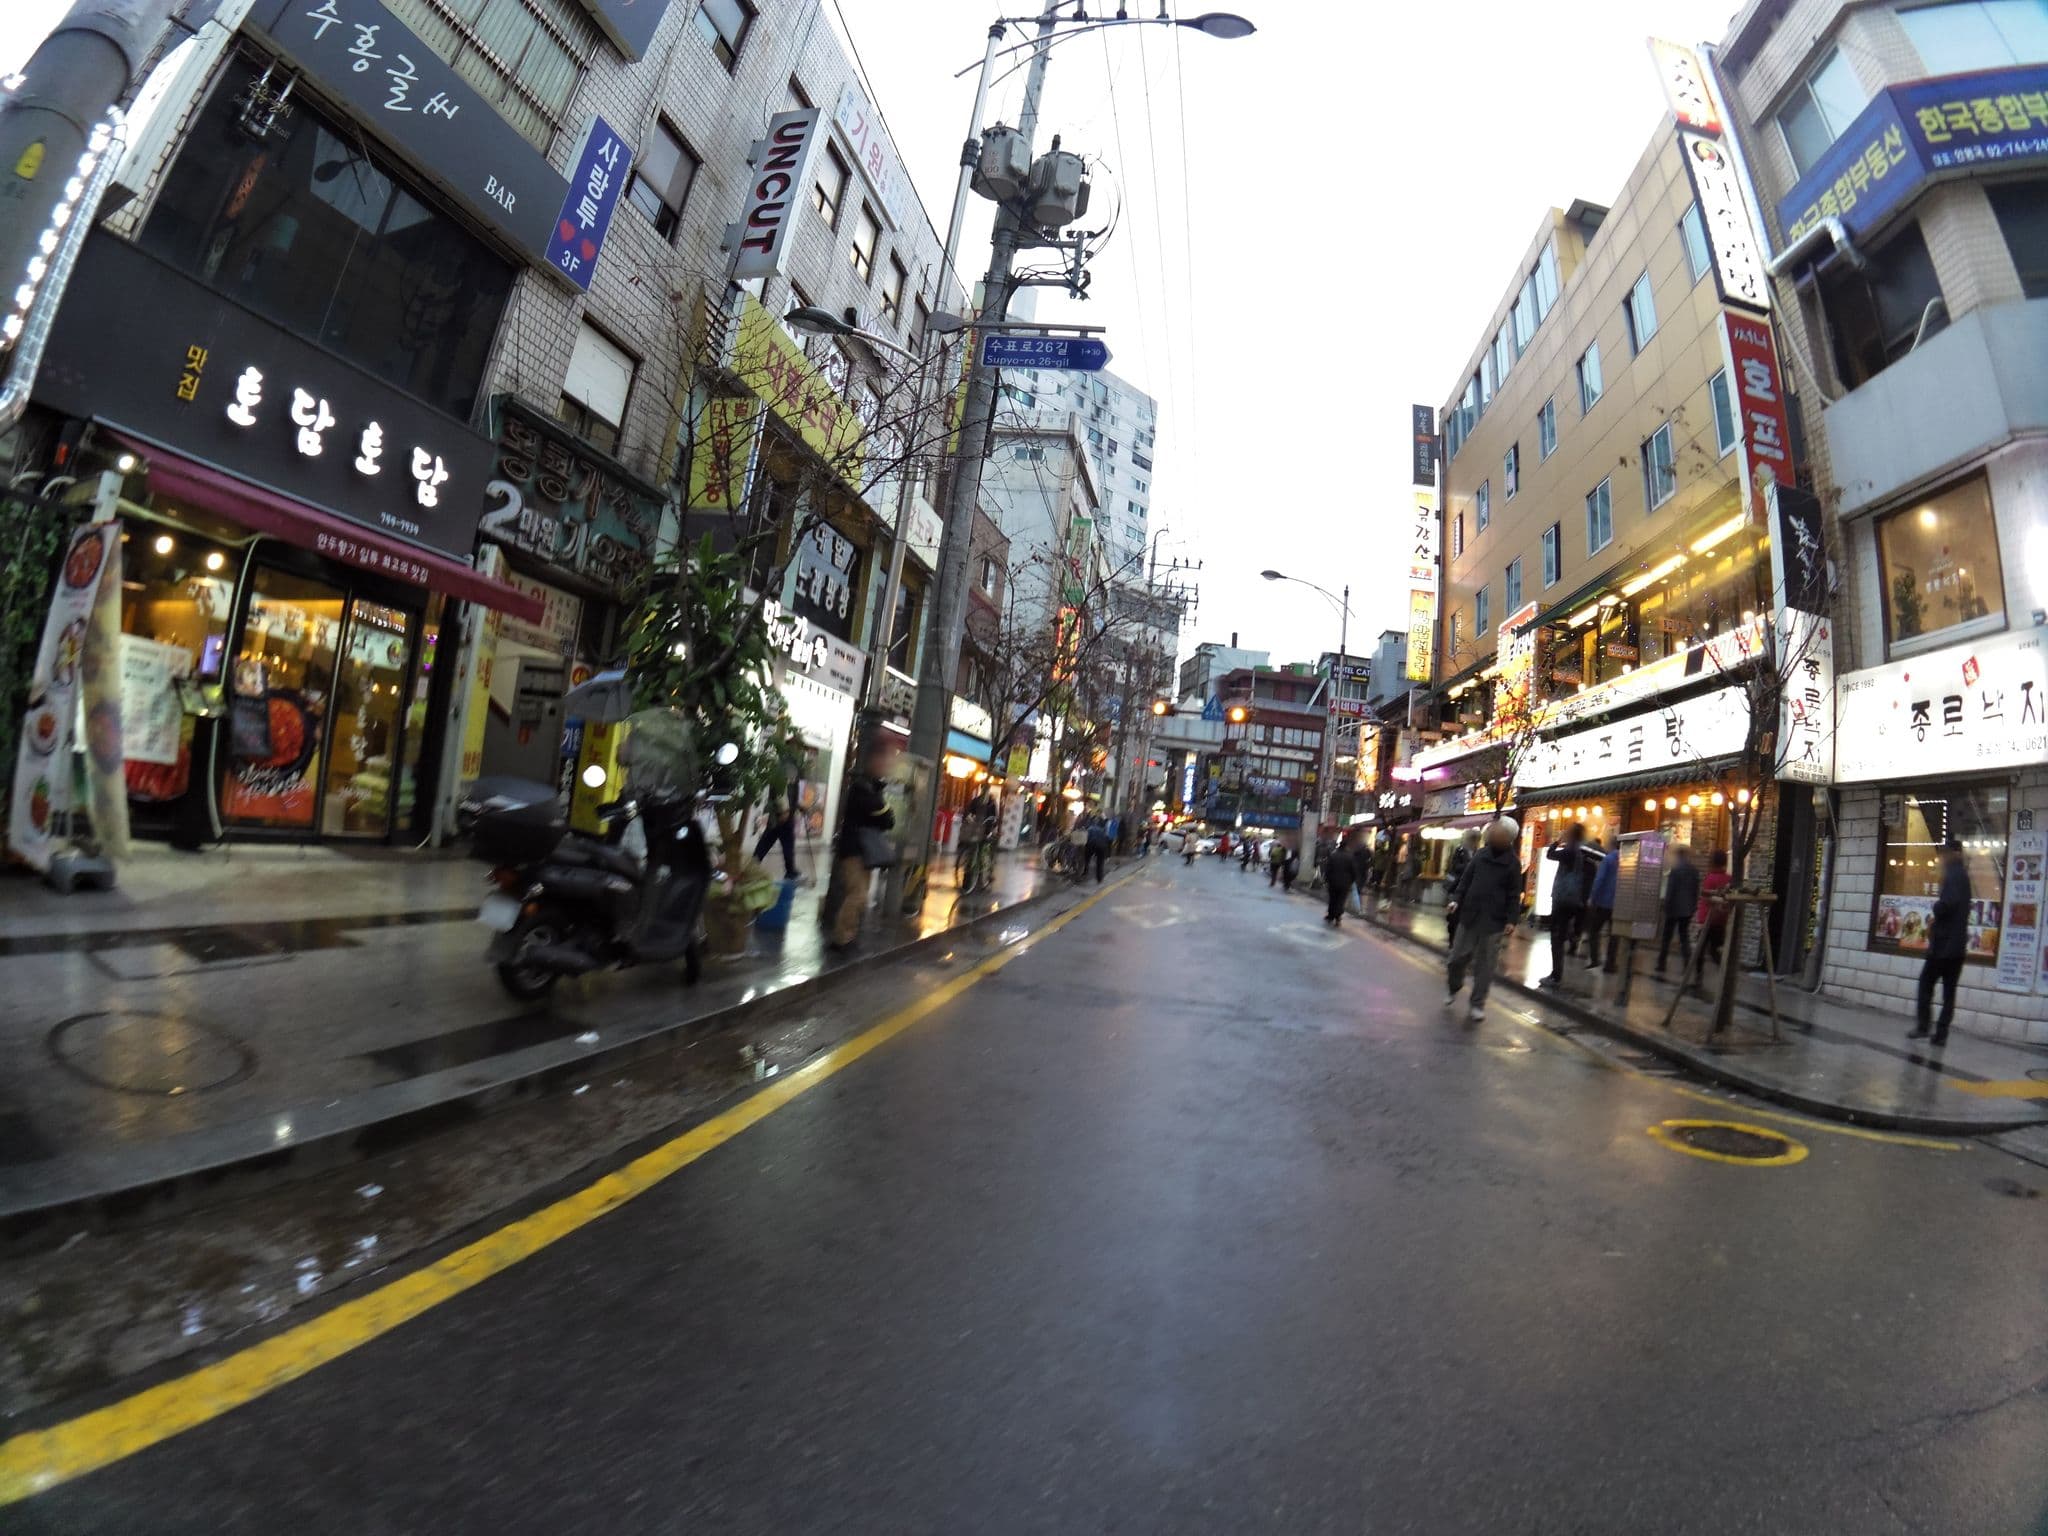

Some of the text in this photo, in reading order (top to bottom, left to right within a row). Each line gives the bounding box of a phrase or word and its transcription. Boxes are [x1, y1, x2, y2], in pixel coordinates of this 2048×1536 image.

[1915, 90, 2048, 144] 한국종합부
[850, 111, 885, 184] 기원
[484, 174, 516, 214] BAR
[576, 137, 621, 230] 사랑투
[742, 120, 809, 254] UNCUT
[561, 250, 581, 272] 3F
[176, 345, 208, 401] 맛집
[986, 355, 1070, 367] Supyo-ro 26-gil
[990, 340, 1069, 356] 수표로26길
[227, 366, 449, 507] 토담토담
[1743, 358, 1785, 461] 호프
[1415, 506, 1430, 560] 금강산
[1803, 657, 1821, 764] 종로낙지
[1842, 679, 1875, 694] SINCE 1992
[1911, 680, 2046, 742] 종로낙지
[2019, 819, 2031, 829] 122
